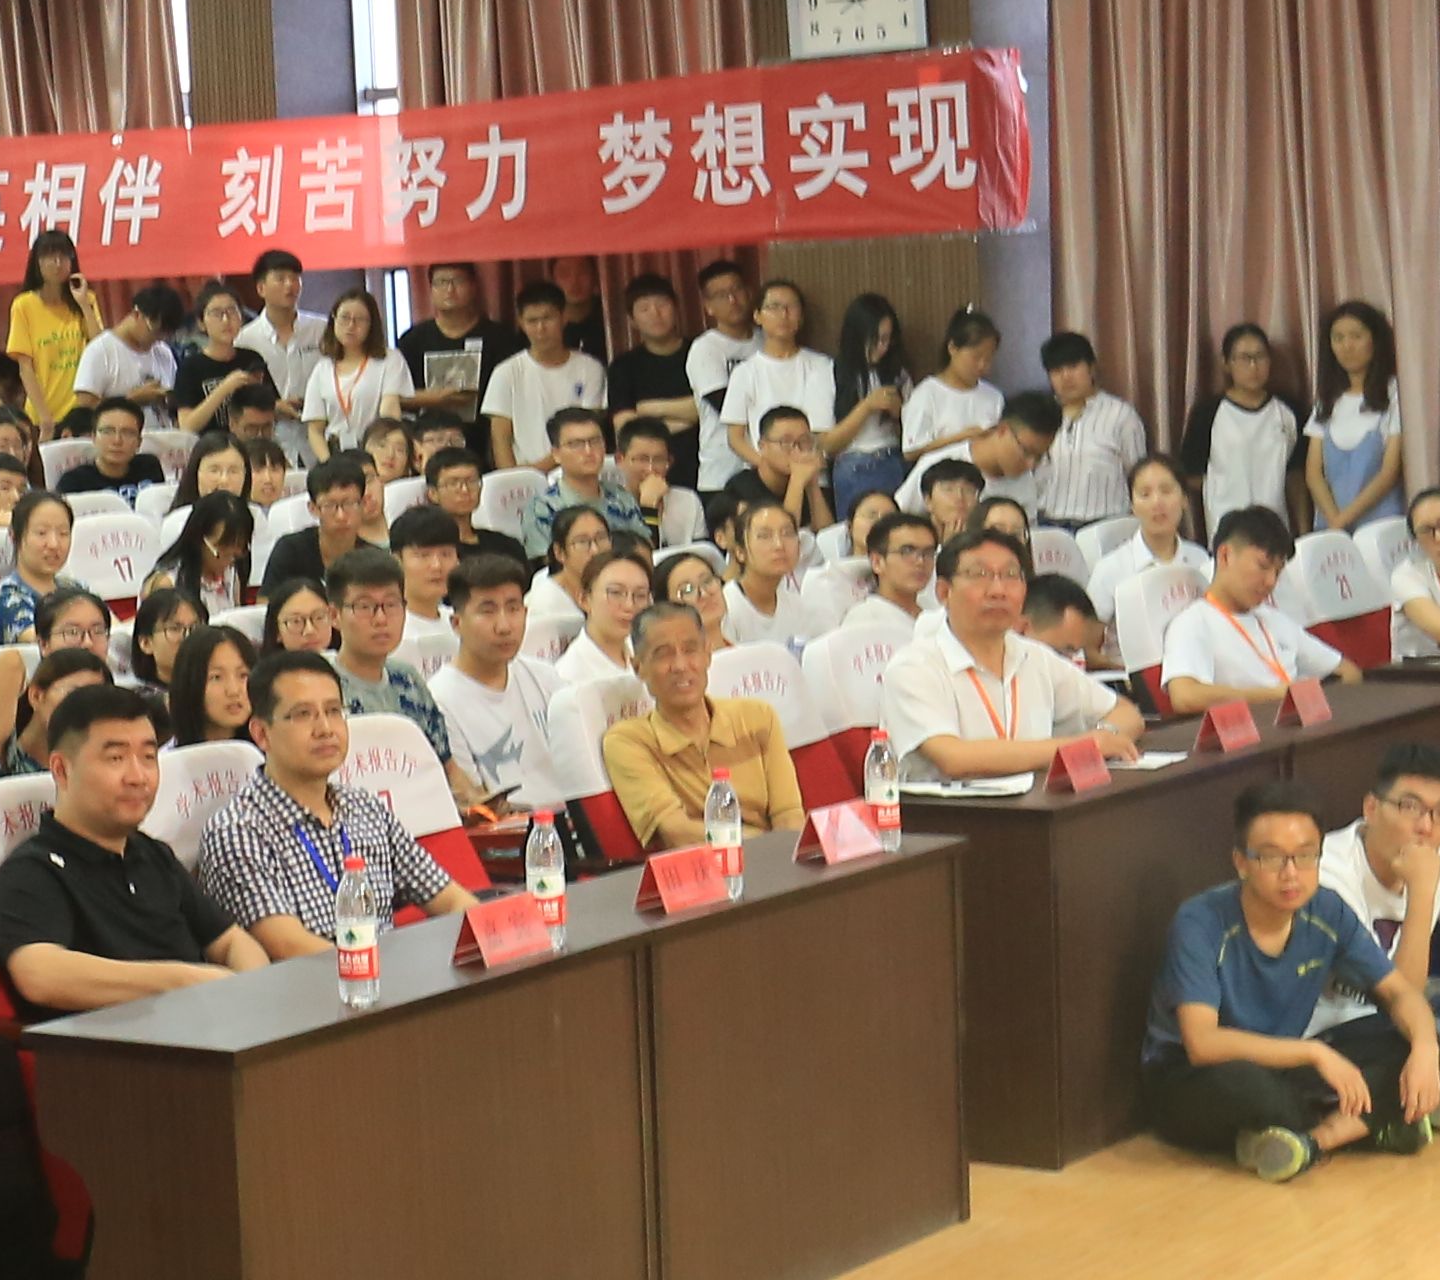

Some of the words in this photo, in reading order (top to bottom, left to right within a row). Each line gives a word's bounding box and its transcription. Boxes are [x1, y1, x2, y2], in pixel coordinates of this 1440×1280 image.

[217, 123, 529, 238] 刻苦努力
[597, 81, 978, 213] 梦想实现
[112, 555, 137, 583] 17
[176, 768, 250, 818] 学术报告
